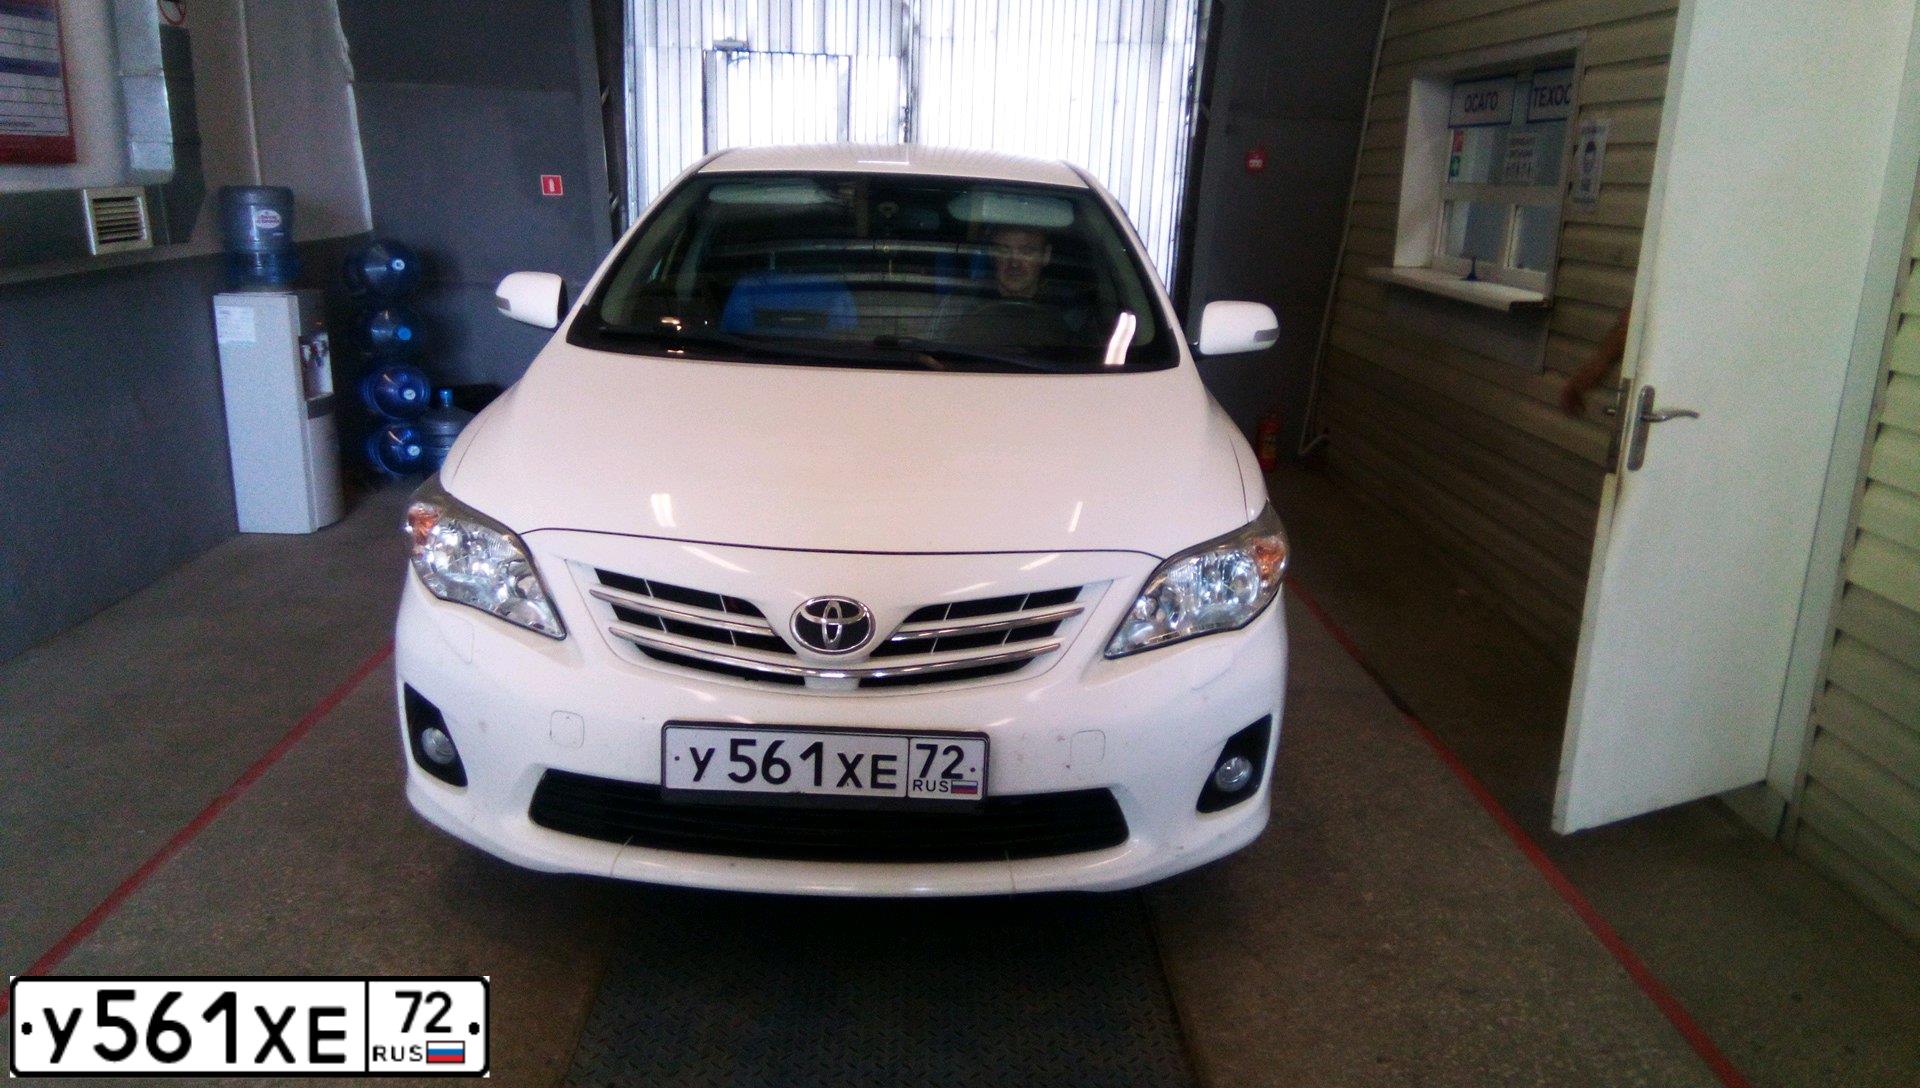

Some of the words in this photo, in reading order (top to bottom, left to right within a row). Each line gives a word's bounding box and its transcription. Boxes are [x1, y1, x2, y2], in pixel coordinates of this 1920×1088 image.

[1464, 91, 1499, 113] ОСАГО
[915, 743, 964, 780] 72
[912, 779, 949, 793] RUS
